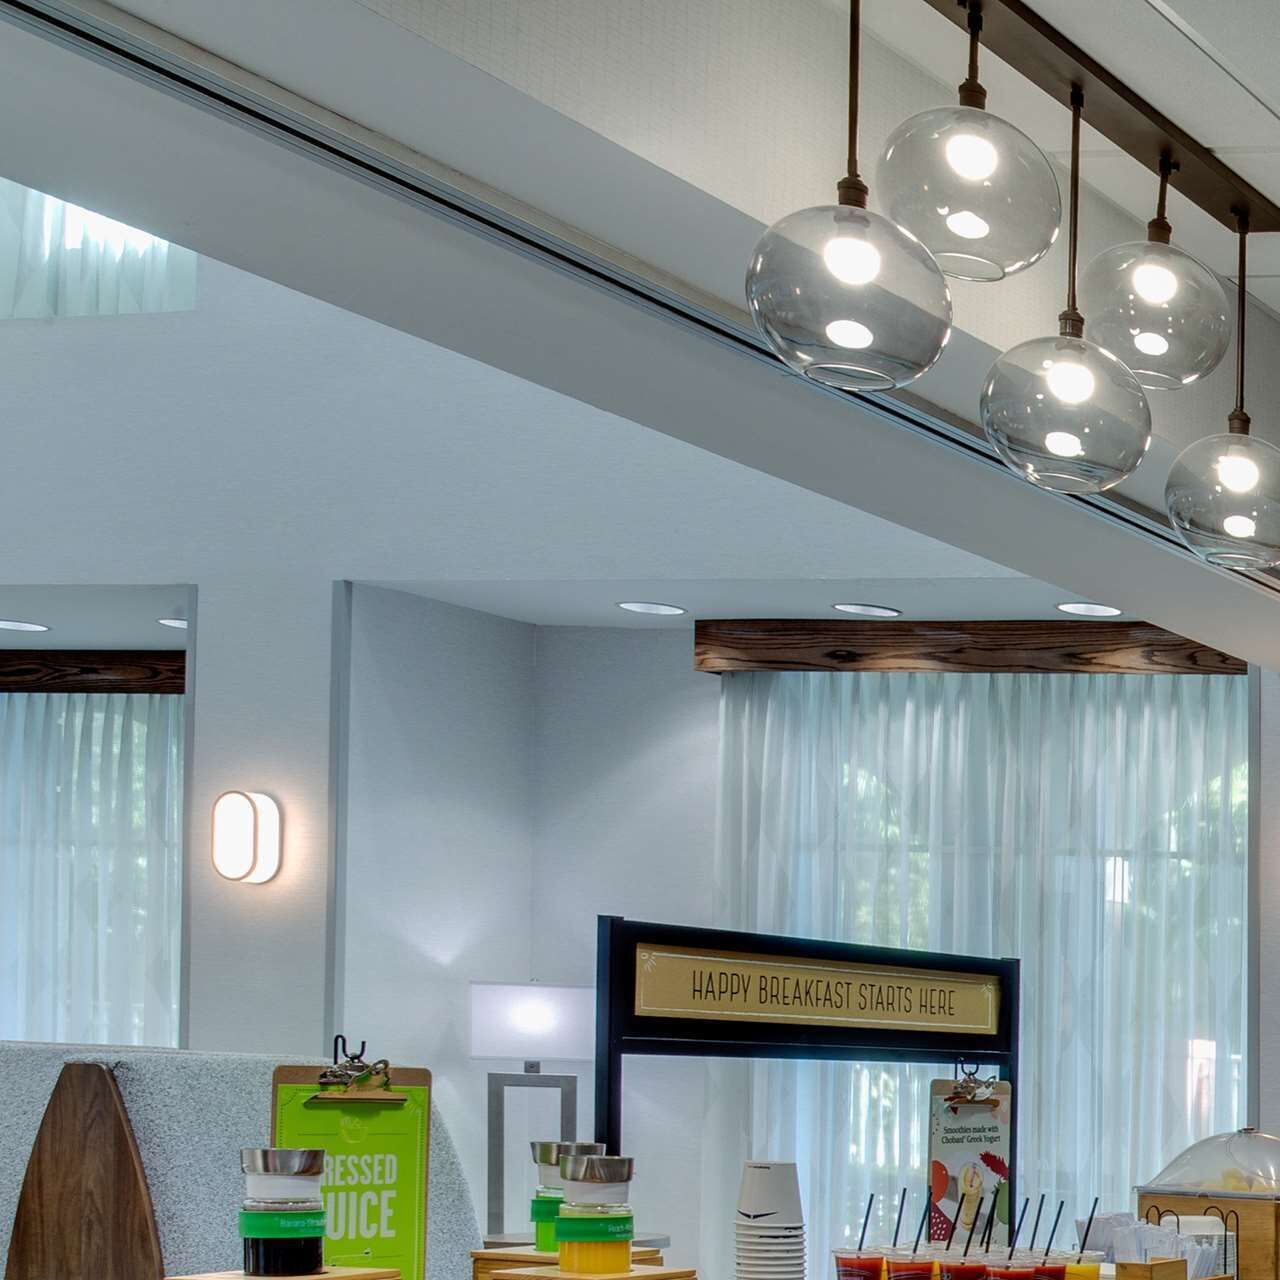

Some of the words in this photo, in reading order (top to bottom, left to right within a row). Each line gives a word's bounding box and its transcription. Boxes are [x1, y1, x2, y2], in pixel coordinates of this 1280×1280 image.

[692, 970, 751, 1003] HAPPY
[759, 974, 852, 1010] BREAKFAST
[858, 983, 913, 1014] STARTS
[919, 988, 956, 1016] HERE
[321, 1154, 398, 1187] RESSED
[321, 1190, 396, 1240] UICE
